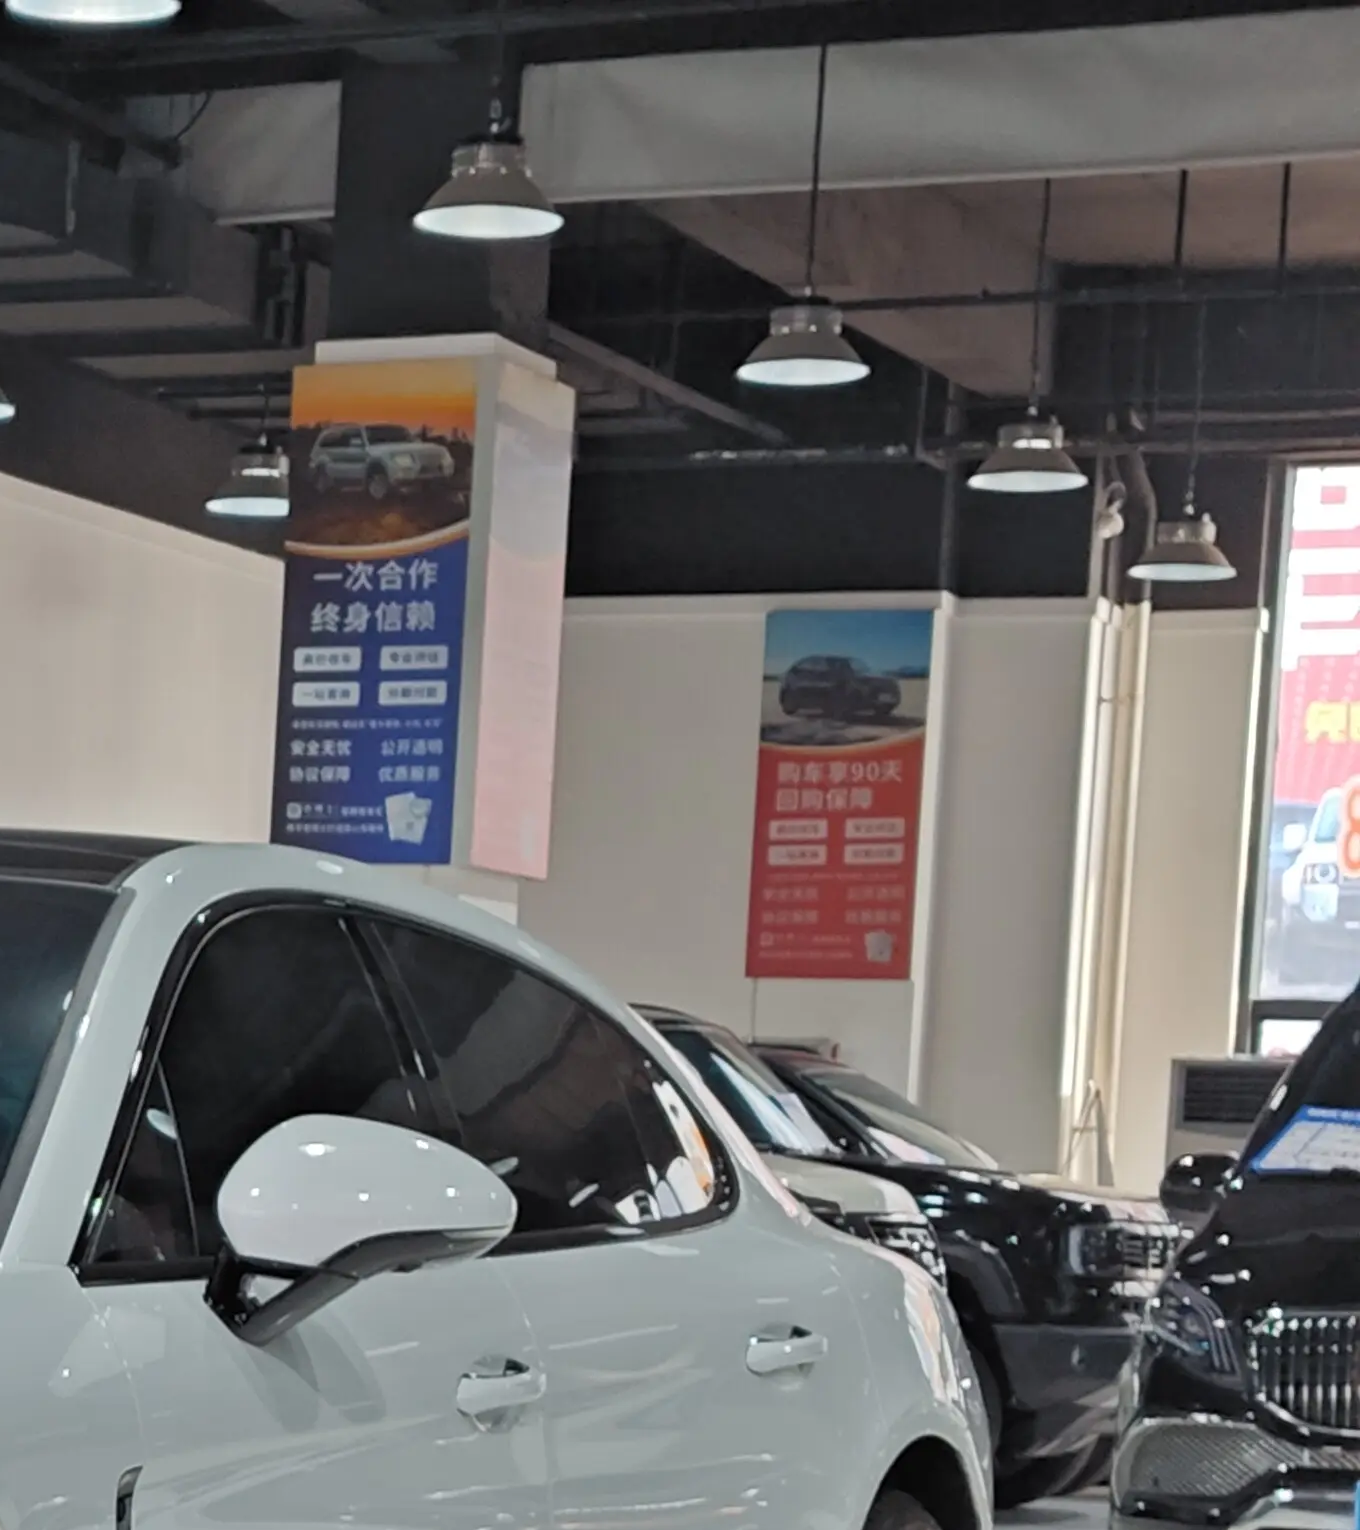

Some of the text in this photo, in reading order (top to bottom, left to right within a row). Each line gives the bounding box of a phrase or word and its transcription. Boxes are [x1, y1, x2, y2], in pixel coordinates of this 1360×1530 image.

[313, 558, 439, 592] 一次合作
[310, 600, 436, 633] 终身信赖
[380, 738, 444, 757] 公开透明
